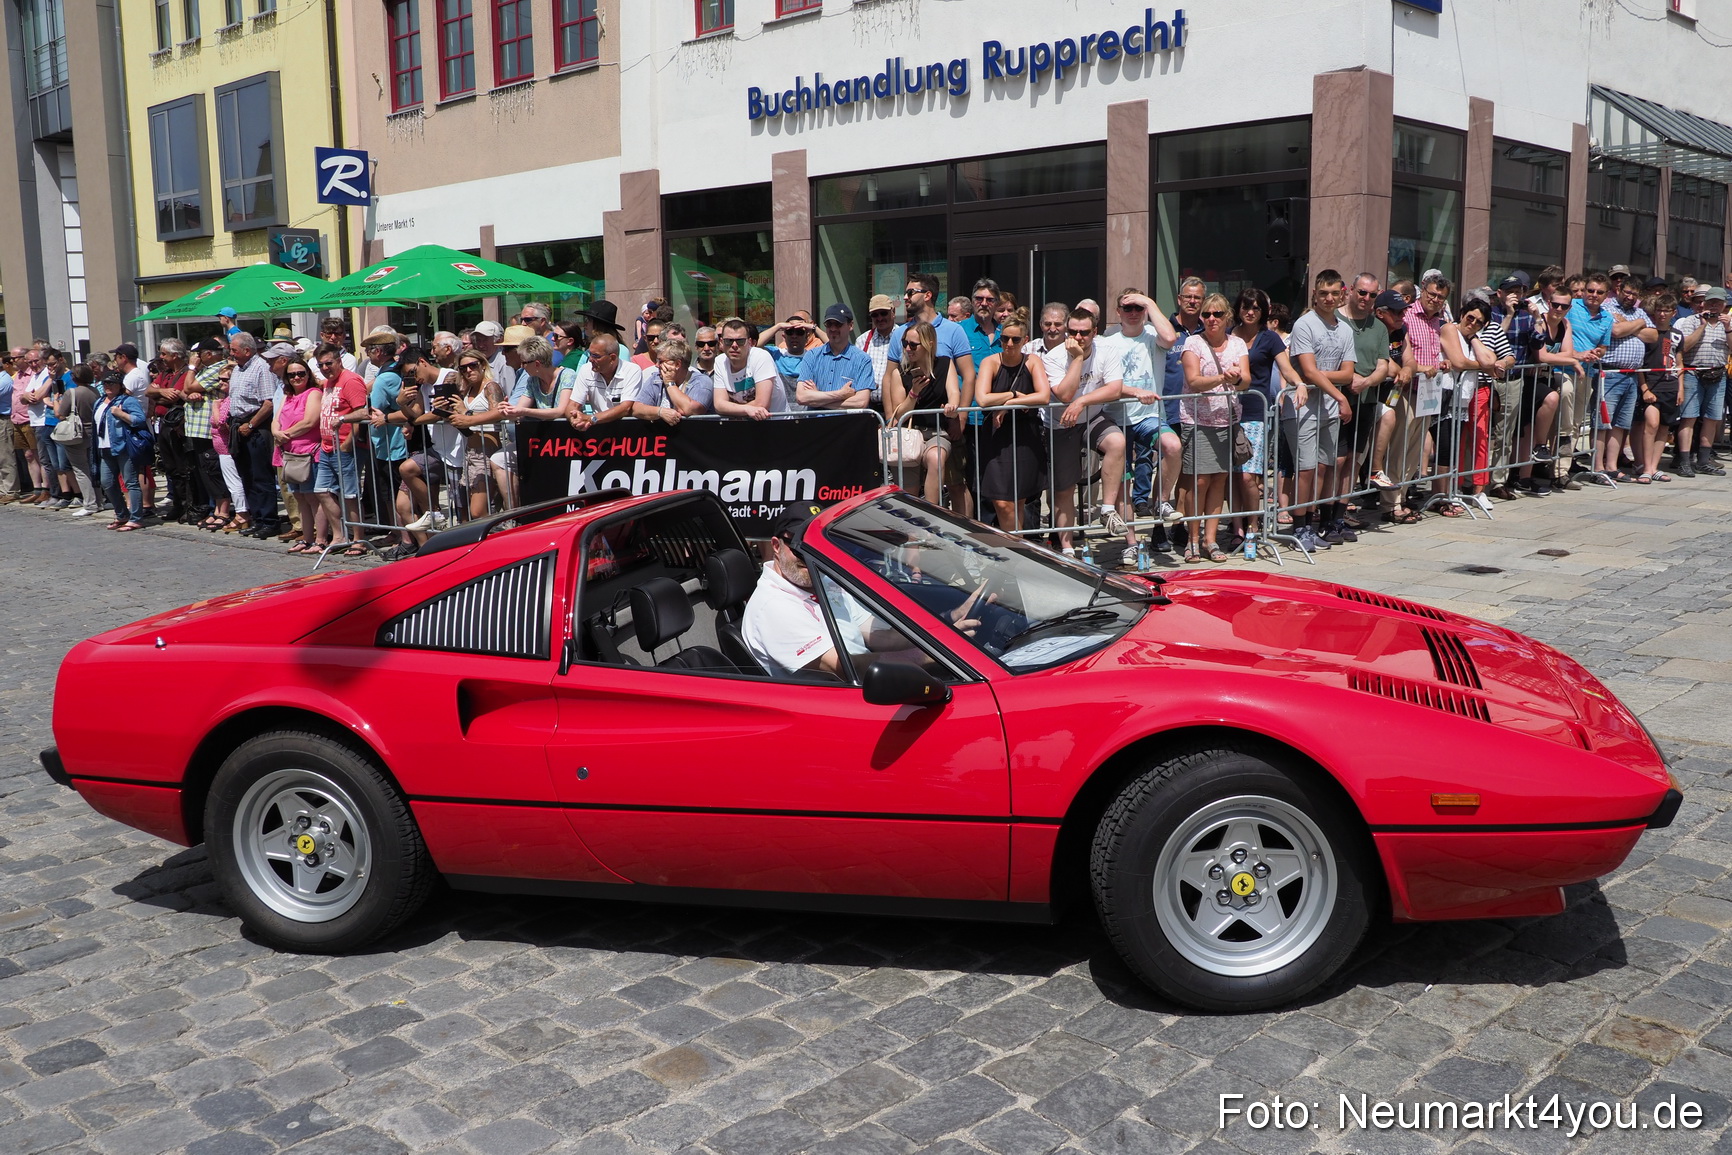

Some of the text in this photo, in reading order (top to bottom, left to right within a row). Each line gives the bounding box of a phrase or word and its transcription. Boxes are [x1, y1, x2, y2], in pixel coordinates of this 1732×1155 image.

[748, 8, 1188, 120] Buchhandlung Rupprecht
[376, 217, 415, 232] Unterer Markt 15
[291, 242, 308, 264] G2
[528, 436, 667, 457] FAHRSCHULE
[568, 459, 862, 502] Kohlmann GmbH
